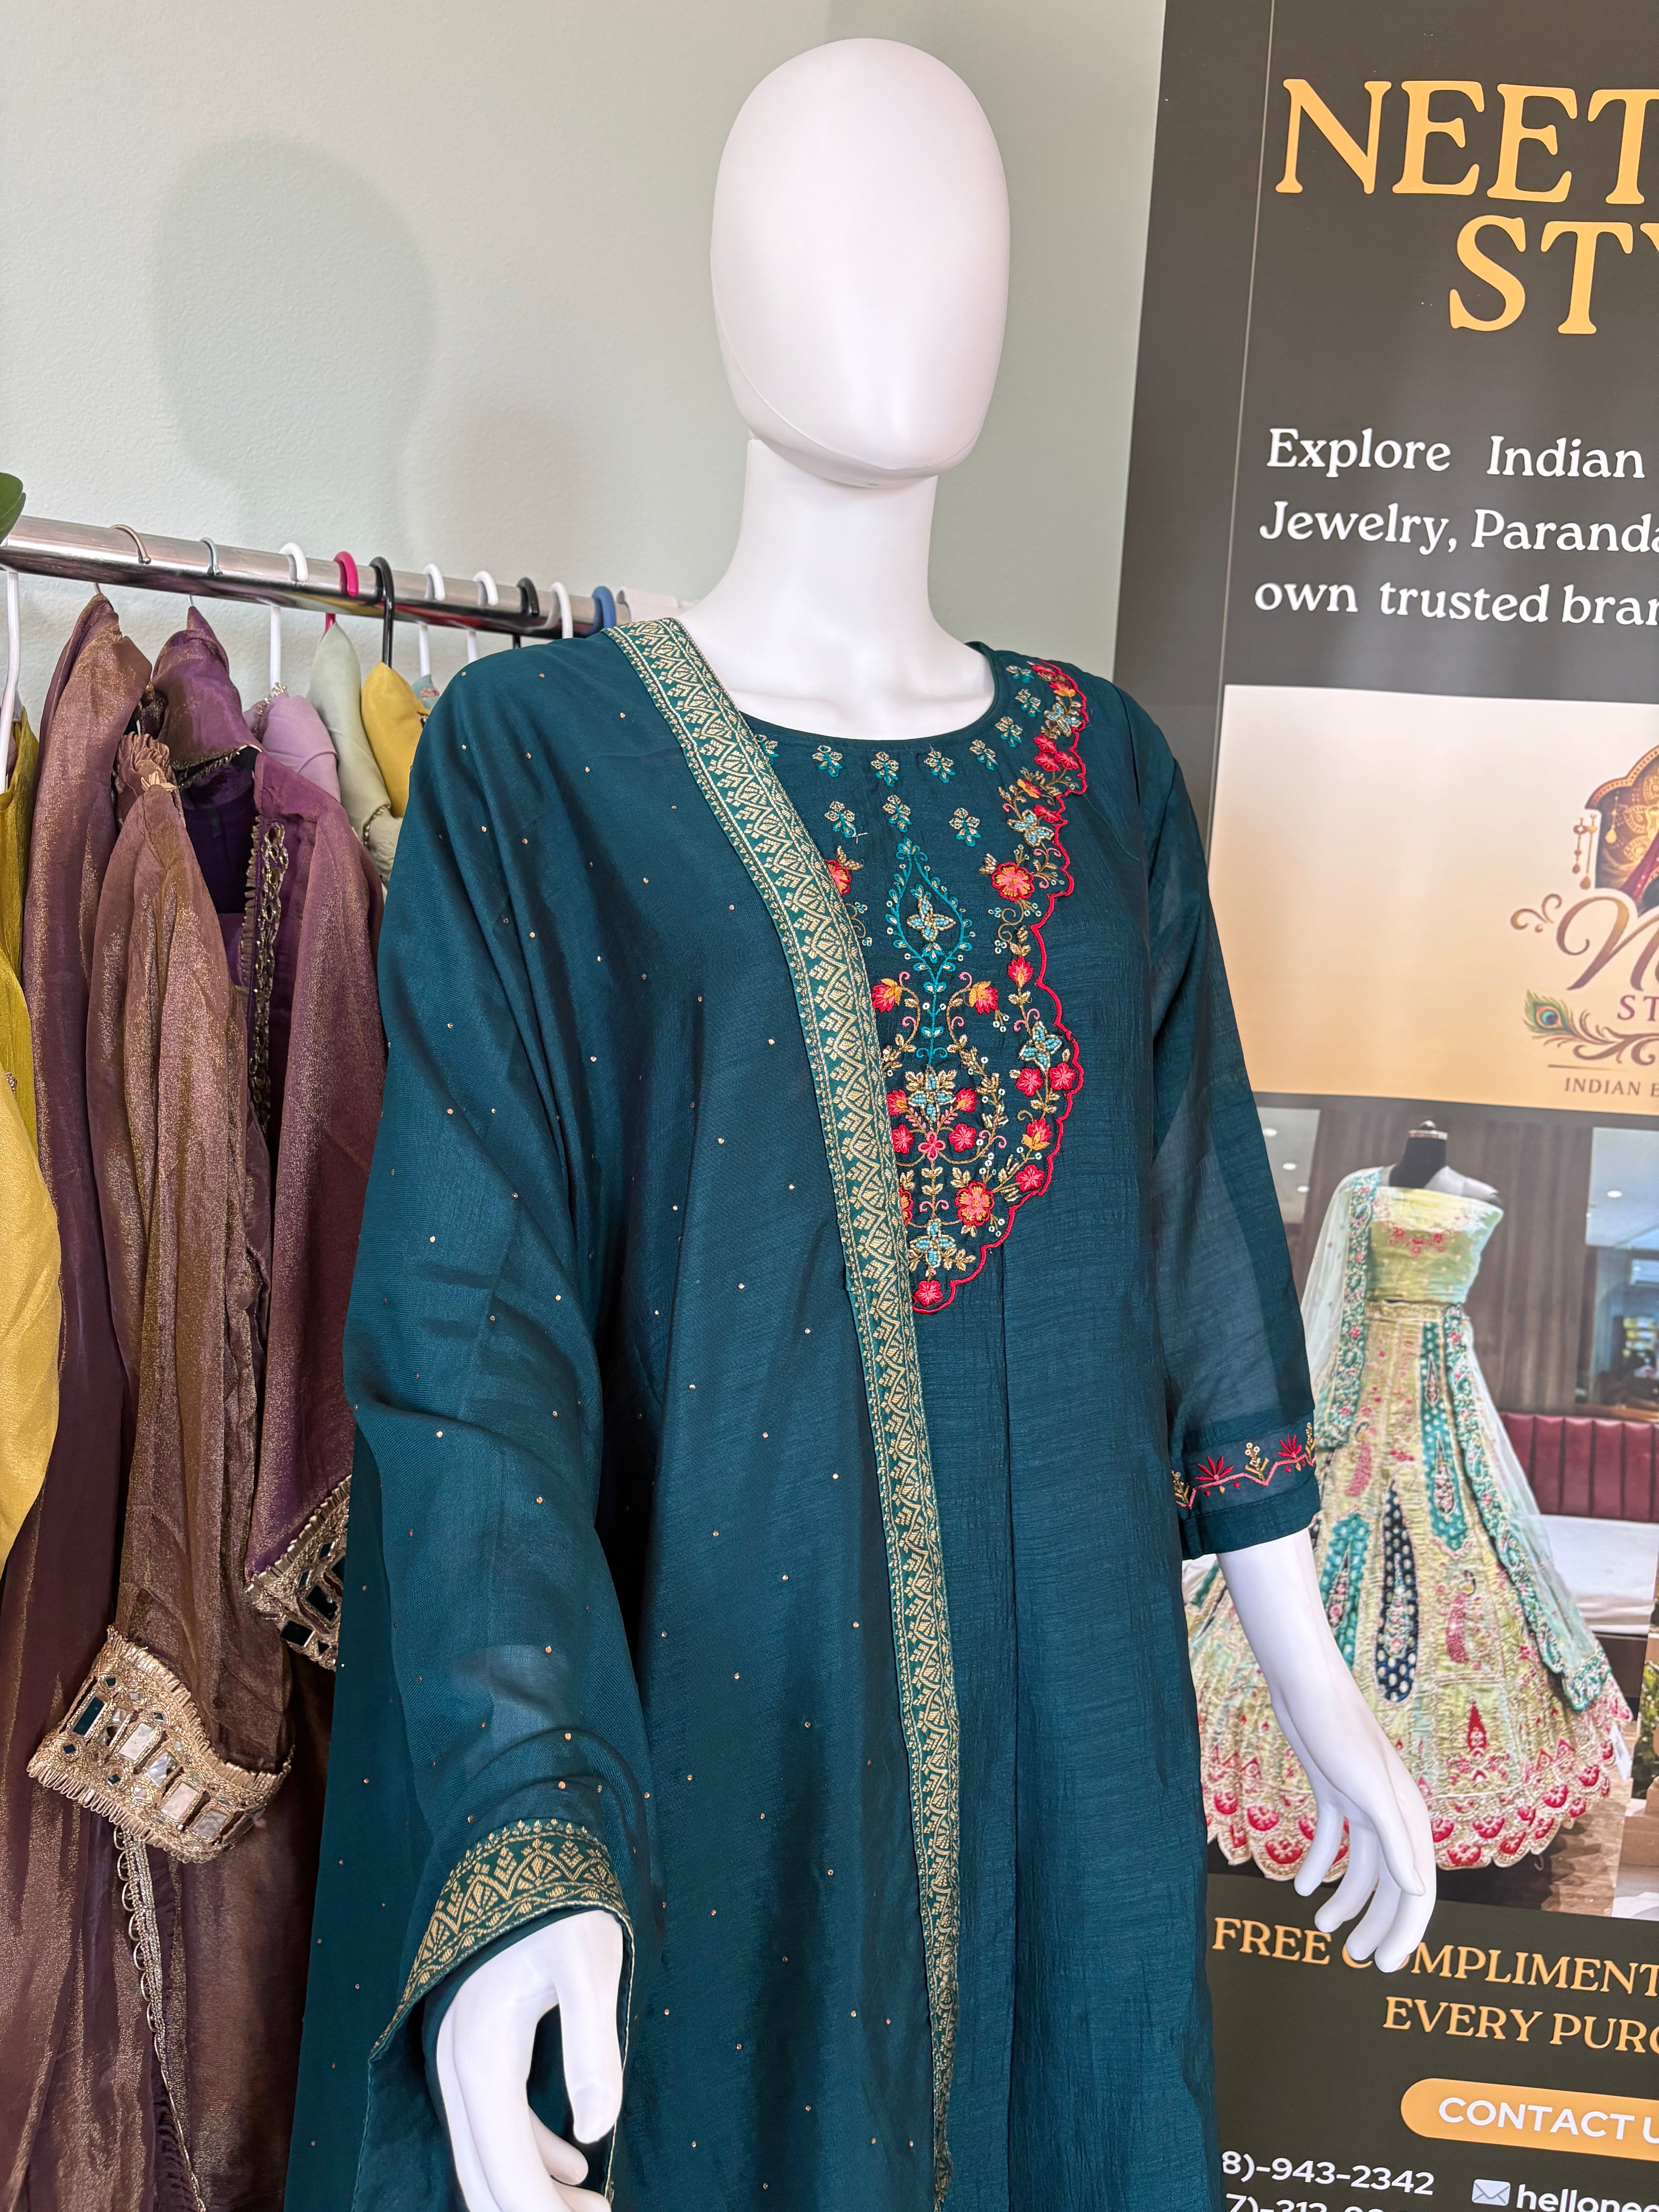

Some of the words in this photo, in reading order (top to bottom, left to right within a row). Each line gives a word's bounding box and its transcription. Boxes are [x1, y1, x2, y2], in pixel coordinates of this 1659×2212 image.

[1274, 79, 1659, 205] NEET
[1449, 215, 1659, 335] ST
[1266, 427, 1451, 478] Explore
[1486, 435, 1645, 479] Indian
[1259, 500, 1457, 556] Jewelry,
[1471, 509, 1659, 553] Parand
[1255, 582, 1358, 613] own
[1379, 582, 1550, 623] trusted
[1564, 1077, 1641, 1096] INDIAN
[1212, 1917, 1332, 1965] FREE
[1342, 1942, 1659, 1997] CMPLIMENT
[1383, 1996, 1542, 2042] EVERY
[1438, 2097, 1635, 2140] CONTACT
[1222, 2150, 1434, 2196] 8)-943-2342
